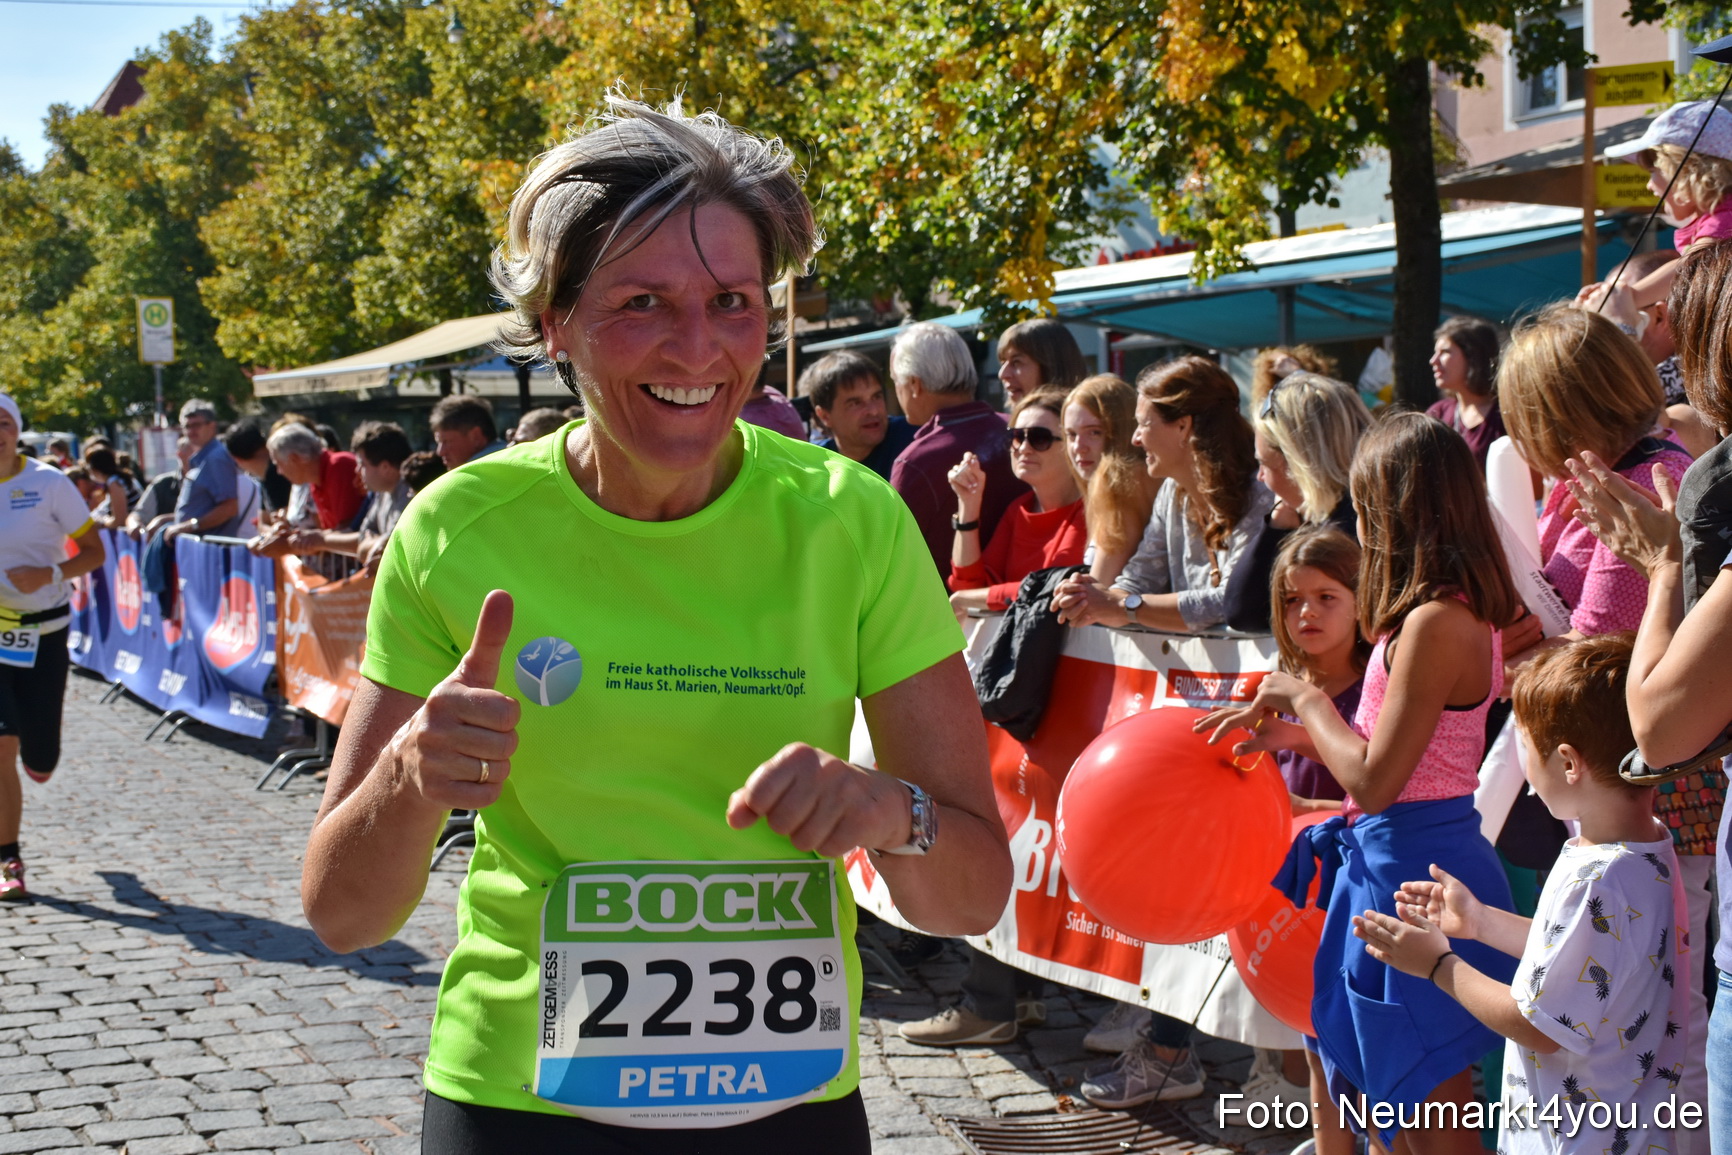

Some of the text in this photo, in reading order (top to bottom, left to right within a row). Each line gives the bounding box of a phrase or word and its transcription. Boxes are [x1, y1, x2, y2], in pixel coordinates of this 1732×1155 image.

[0, 631, 31, 648] 95
[608, 661, 807, 680] Freie katholische Volksschule
[606, 677, 807, 698] im Haus St. Marien, Neumarkt/Opf.
[570, 876, 814, 929] BOCK
[1065, 910, 1099, 936] Sicher
[821, 961, 833, 975] D
[578, 956, 818, 1039] 2238
[618, 1063, 768, 1099] PETRA
